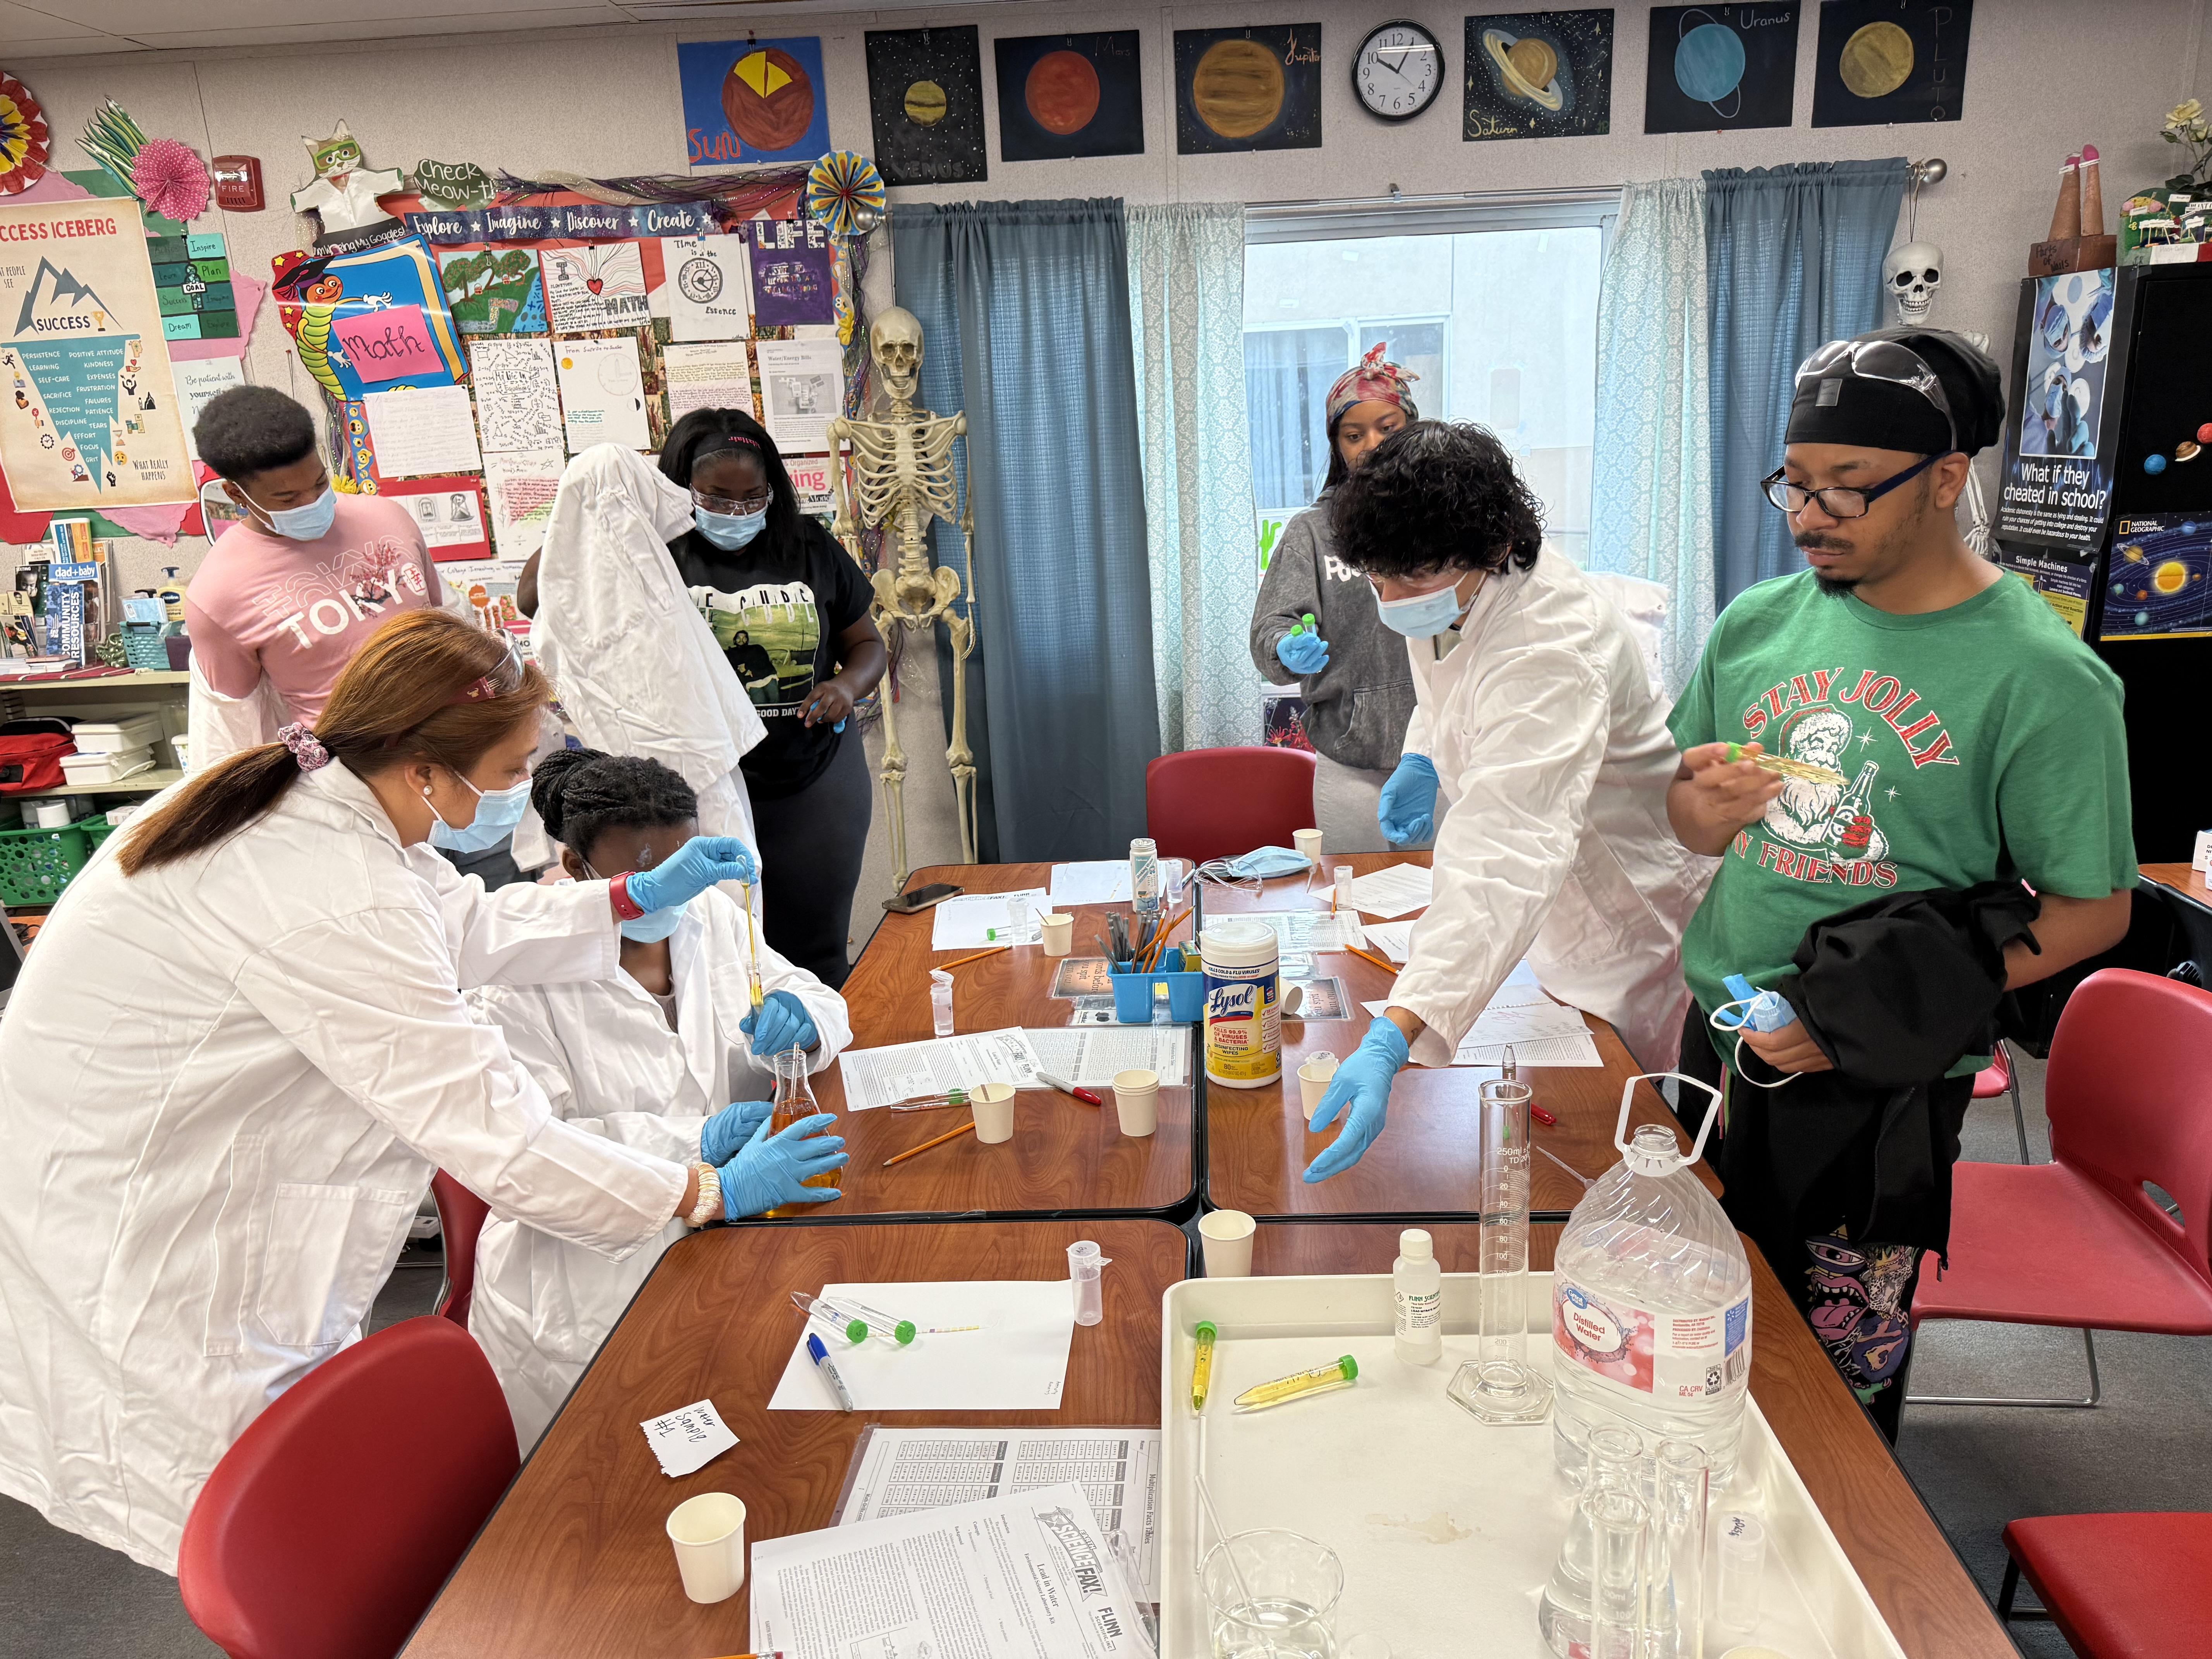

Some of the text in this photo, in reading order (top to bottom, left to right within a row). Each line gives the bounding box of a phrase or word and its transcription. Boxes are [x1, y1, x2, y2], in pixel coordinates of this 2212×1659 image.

[1740, 10, 1790, 29] Uranus
[1379, 39, 1387, 48] 11
[1392, 33, 1403, 46] 12
[1368, 52, 1378, 64] 10
[1420, 51, 1427, 61] 2
[1363, 68, 1370, 80] 9
[1425, 64, 1431, 76] 3
[1368, 83, 1374, 95] 8
[1418, 80, 1425, 92] 4
[1379, 95, 1386, 107] 7
[1393, 97, 1400, 109] 6
[1408, 93, 1415, 105] 5
[1467, 110, 1517, 137] Saturn
[891, 161, 963, 179] VENUS
[0, 218, 117, 242] CCESS ICEBERG
[414, 210, 694, 240] Explore Imagine Discover Create
[756, 220, 825, 249] LIFE
[190, 241, 216, 252] Inspire
[2036, 245, 2057, 259] Parts
[2044, 254, 2051, 266] of
[6, 266, 26, 276] PEOPLE
[202, 266, 221, 276] Plan
[4, 278, 14, 288] SEE
[163, 295, 187, 305] Success
[605, 295, 649, 316] MATH
[36, 316, 90, 331] SUCCESS
[168, 323, 191, 332] Dream
[343, 326, 424, 361] Math
[185, 375, 198, 385] Be
[198, 374, 220, 386] patient
[141, 471, 166, 481] HAPPENS
[2022, 463, 2090, 490] What if they
[2004, 483, 2106, 510] cheated in school?
[55, 565, 95, 577] dad+baby
[2016, 555, 2037, 567] Simple
[2039, 560, 2068, 573] Machines
[62, 592, 70, 656] COMMUNITY
[71, 592, 80, 658] RESOURCES
[1743, 667, 1960, 770] STAY JOLLY
[1757, 840, 1898, 888] FRIENDS
[1210, 985, 1253, 1017] Lysol
[1497, 1147, 1522, 1155] 250ml
[1573, 1312, 1605, 1334] Distilled
[1576, 1324, 1601, 1341] Water
[1147, 1474, 1156, 1510] Multiplication
[1079, 1530, 1097, 1550] EARTH
[1145, 1527, 1154, 1544] Tables
[1054, 1524, 1102, 1593] SCIENCE FAX!
[1037, 1563, 1049, 1579] Lead
[1047, 1587, 1059, 1607] Water
[1097, 1607, 1123, 1638] FLINN
